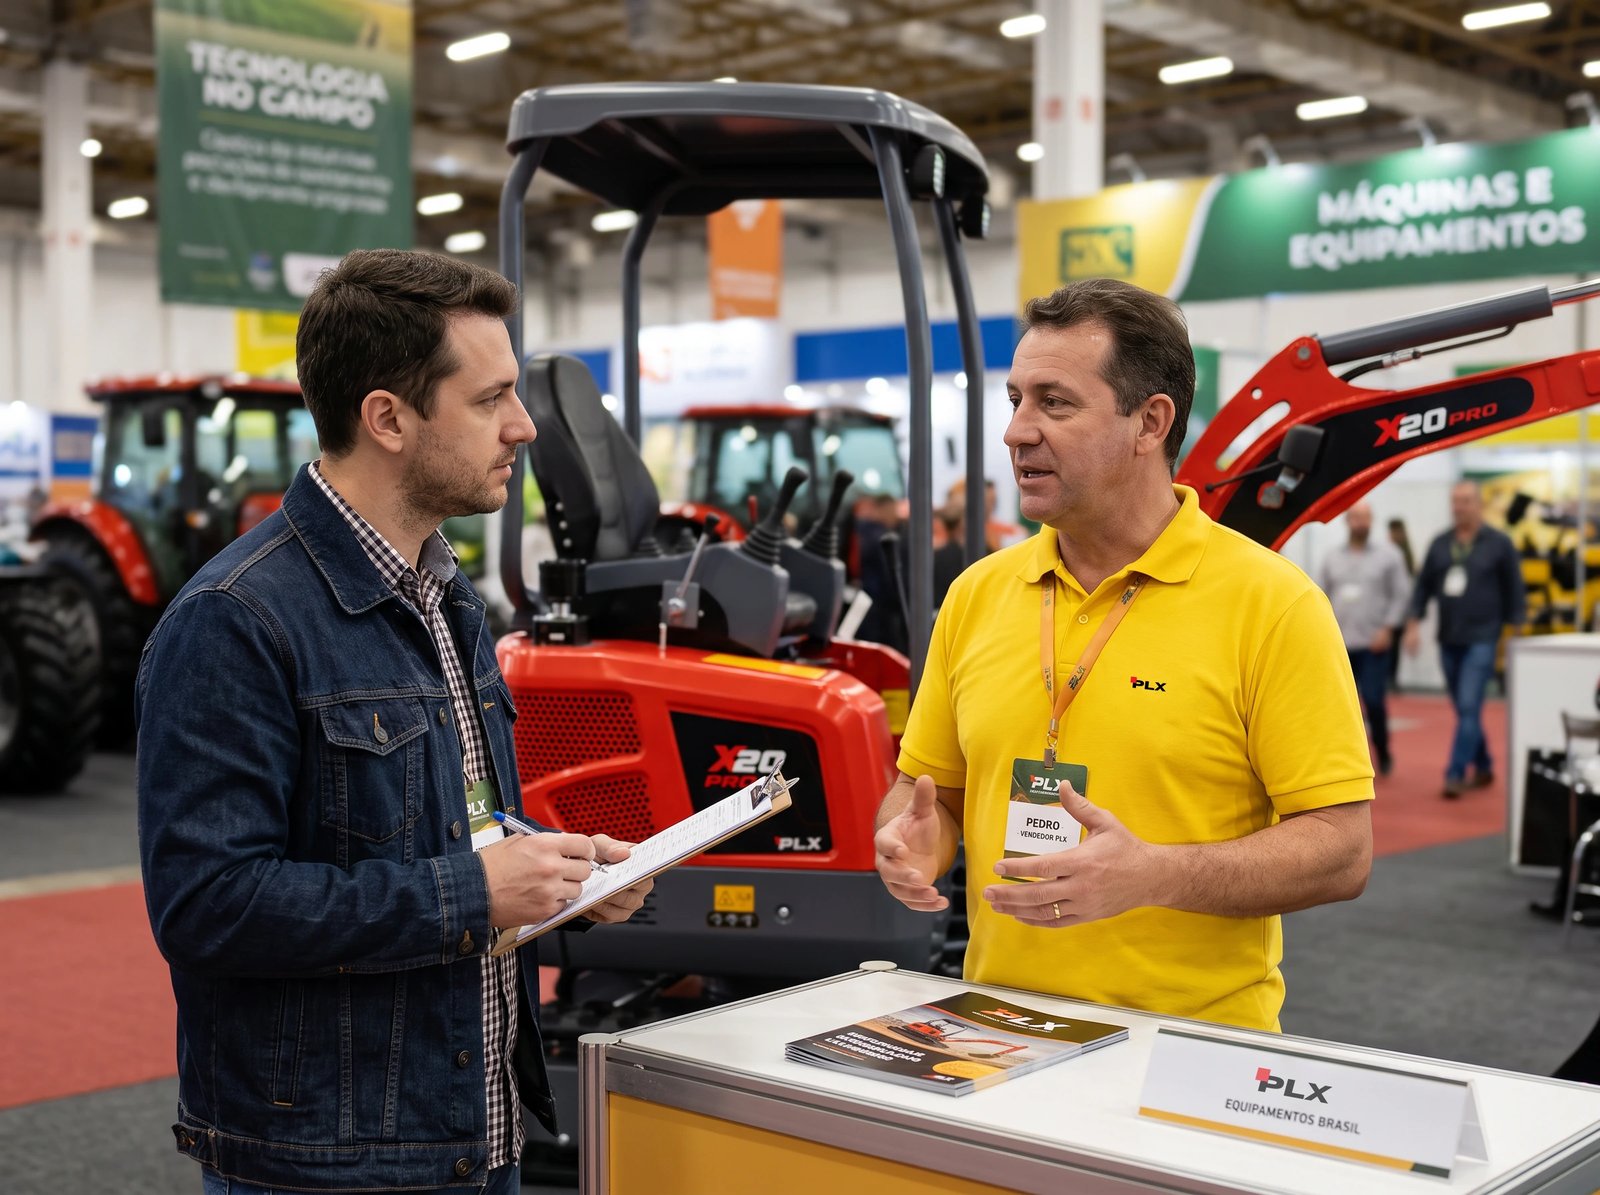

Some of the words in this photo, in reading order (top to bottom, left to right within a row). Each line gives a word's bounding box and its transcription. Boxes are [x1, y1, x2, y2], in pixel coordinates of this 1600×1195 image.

[187, 40, 388, 103] TECNOLOGIA
[203, 76, 254, 110] NO
[259, 85, 375, 130] CAMPO
[1318, 171, 1519, 225] MÁQUINAS
[1525, 167, 1553, 204] E
[1289, 206, 1586, 271] EQUIPAMENTOS
[1373, 407, 1447, 448] X20
[1449, 403, 1497, 426] PRO
[1130, 676, 1167, 692] PLX
[707, 745, 787, 774] X20
[1020, 830, 1054, 841] VENDEDOR
[1055, 835, 1067, 843] PLX
[1026, 817, 1060, 830] PEDRO
[775, 836, 822, 851] PLX
[1255, 1067, 1332, 1104] PLX
[1225, 1098, 1315, 1125] EQUIPAMENTOS
[1318, 1116, 1361, 1135] BRASIL
